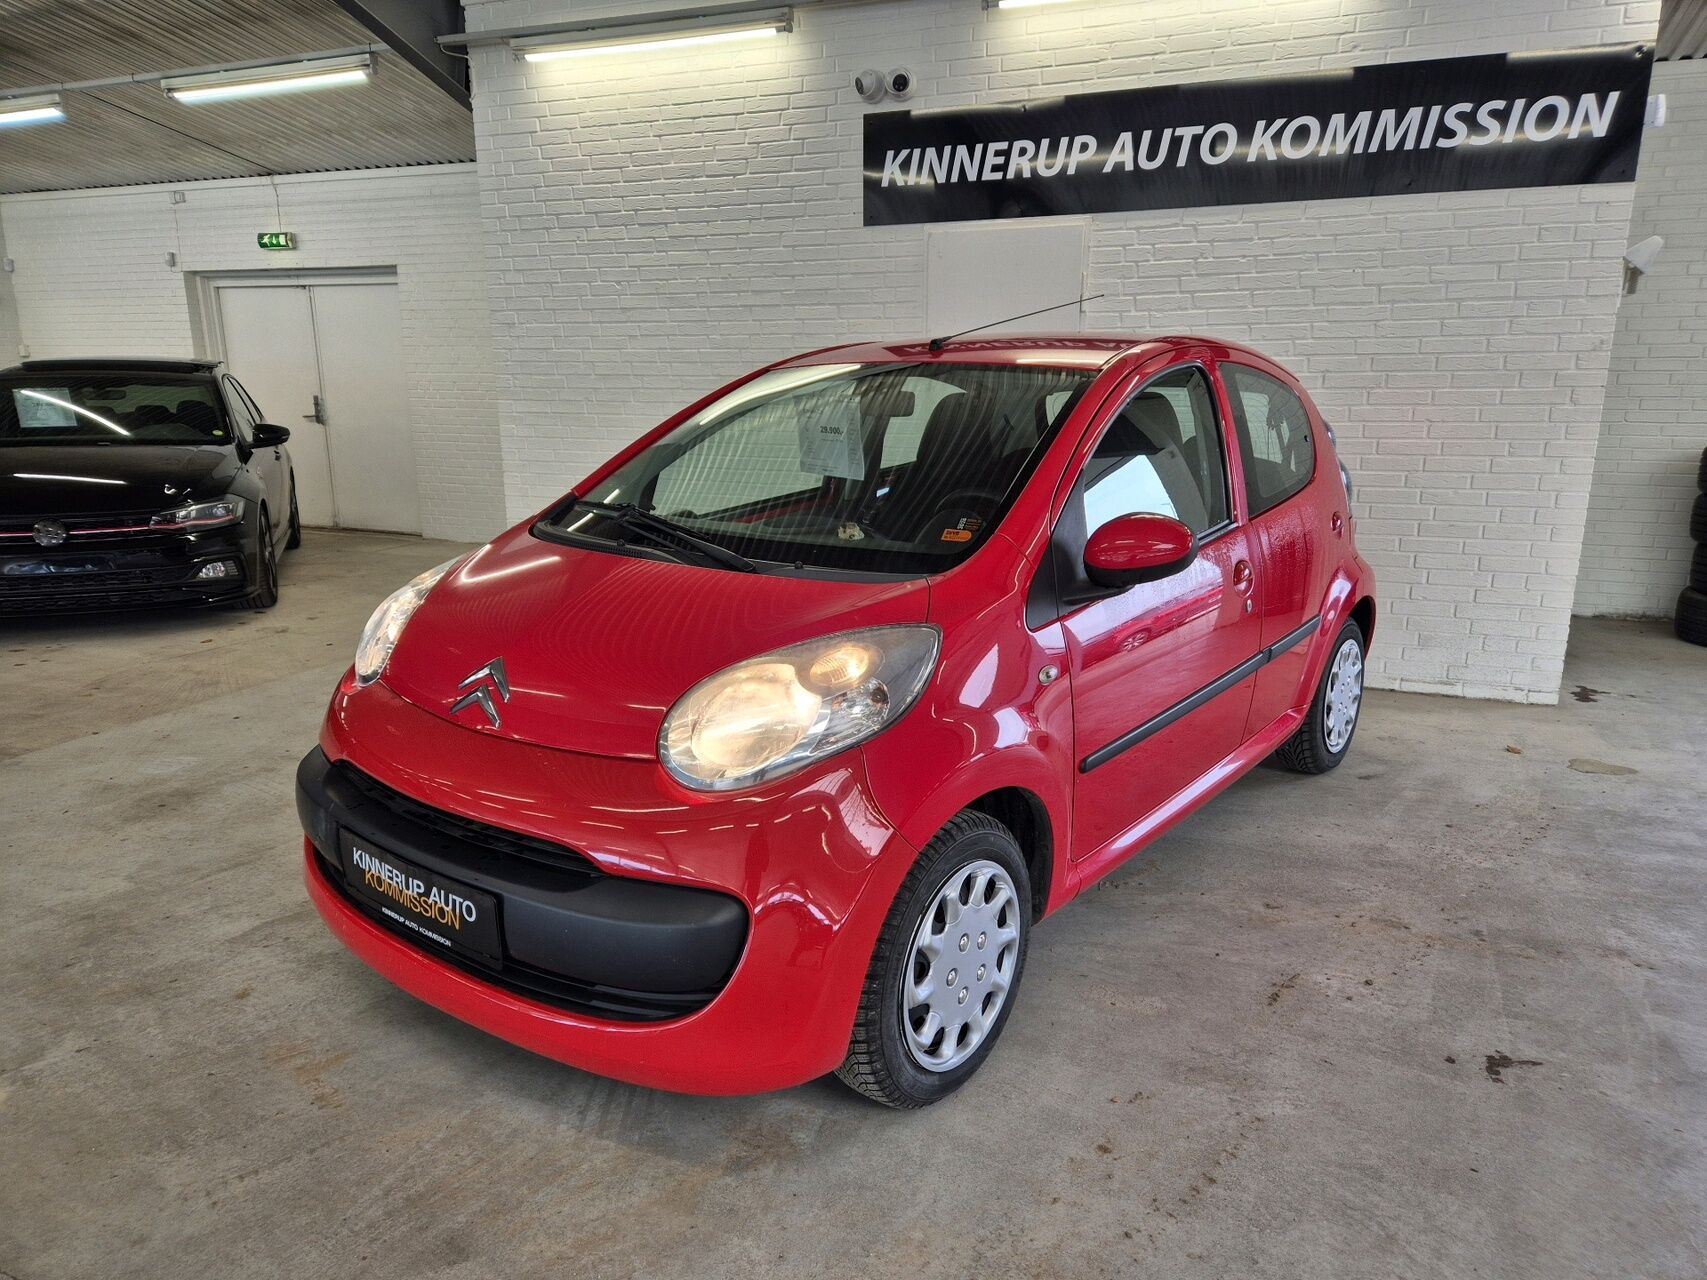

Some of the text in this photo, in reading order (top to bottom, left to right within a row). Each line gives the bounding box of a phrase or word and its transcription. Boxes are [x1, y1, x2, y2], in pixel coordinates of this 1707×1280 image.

[881, 91, 1623, 187] KINNERUP AUTO KOMMISSION
[353, 847, 477, 923] KINNERUP AUTO
[365, 869, 461, 930] KOMMISSION
[382, 906, 452, 947] KINNERUP AUTO KOMMISSION
